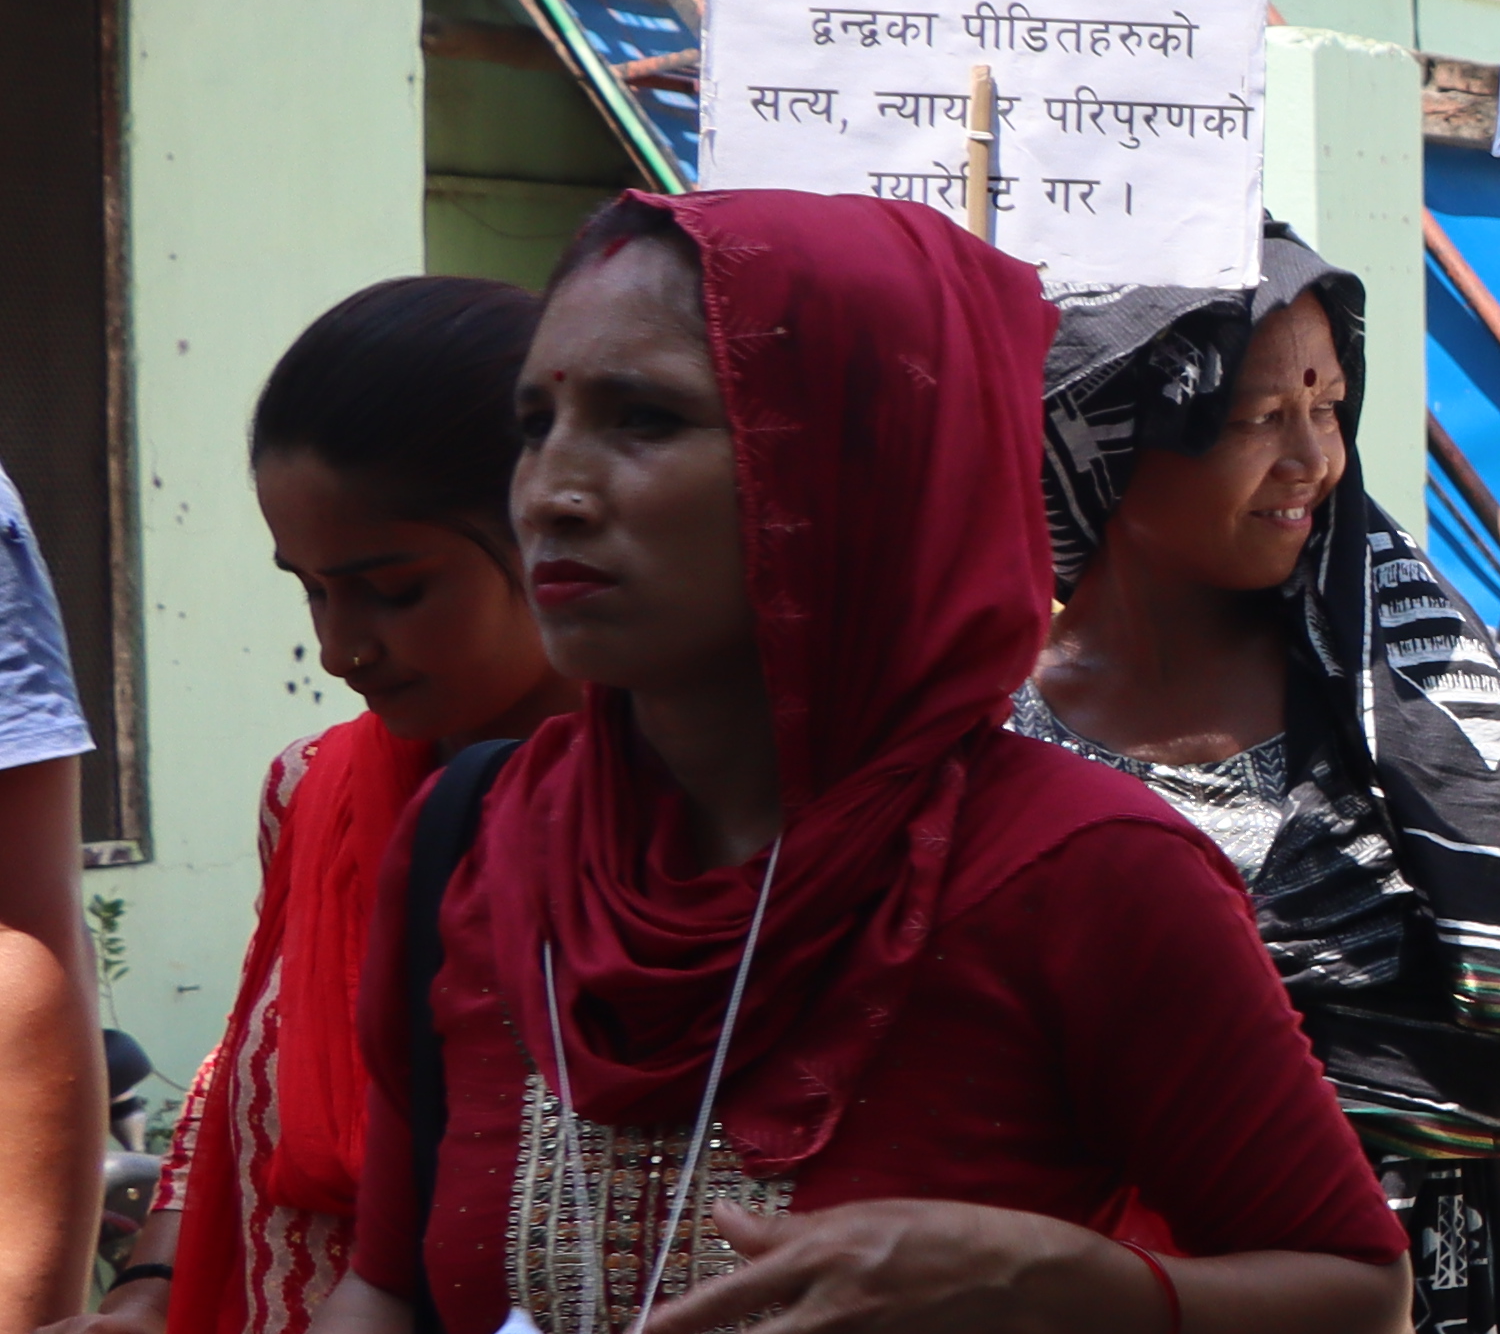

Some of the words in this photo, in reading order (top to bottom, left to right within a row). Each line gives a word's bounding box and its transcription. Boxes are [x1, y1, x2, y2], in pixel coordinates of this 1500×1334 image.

[809, 7, 939, 48] द्वन्द्वका
[963, 1, 1199, 59] पीडितहरुको
[748, 85, 849, 134] सत्य,
[874, 91, 970, 128] न्याय
[996, 95, 1021, 131] र
[1045, 85, 1254, 150] परिपुरणको
[1043, 177, 1101, 216] गर
